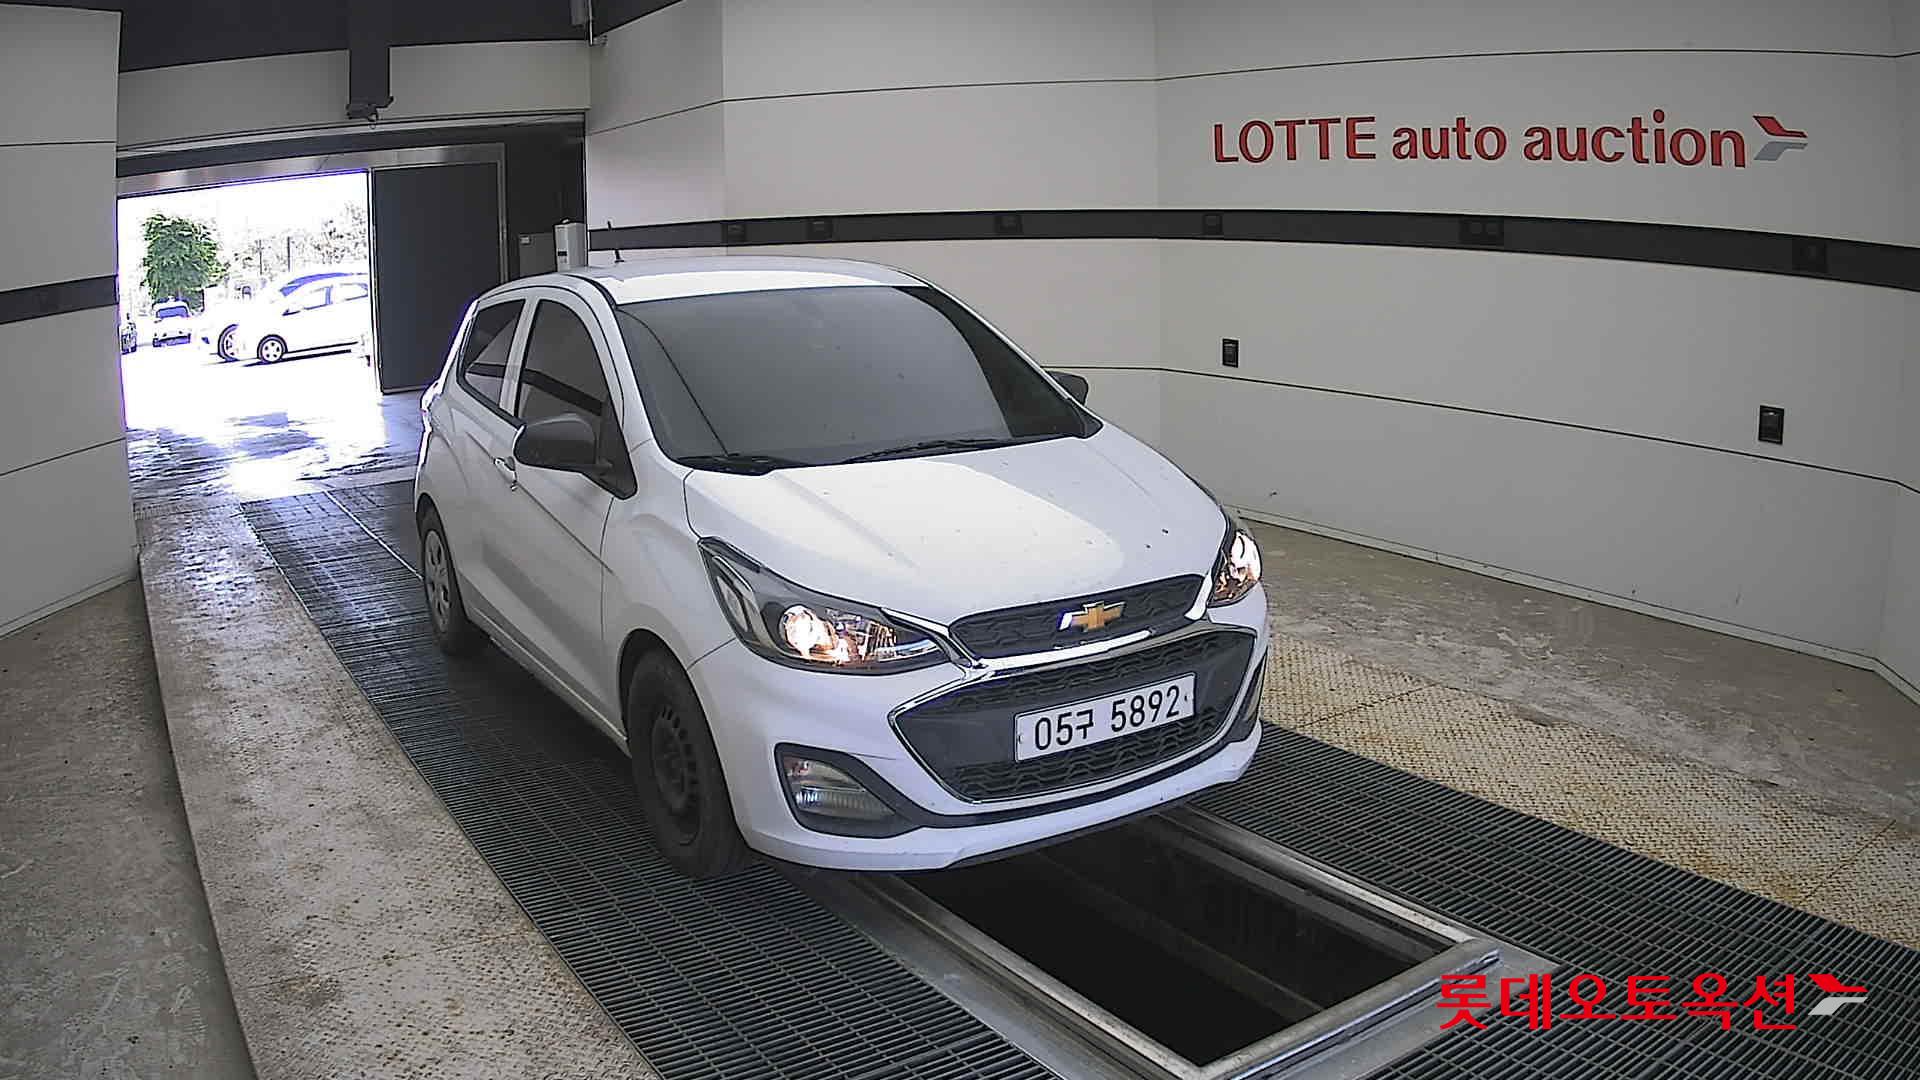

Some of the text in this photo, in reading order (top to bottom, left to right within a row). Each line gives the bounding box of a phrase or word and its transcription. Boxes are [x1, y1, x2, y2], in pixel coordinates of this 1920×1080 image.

[1213, 109, 1747, 169] LOTTE auto auction
[1034, 685, 1181, 751] 05구 5892
